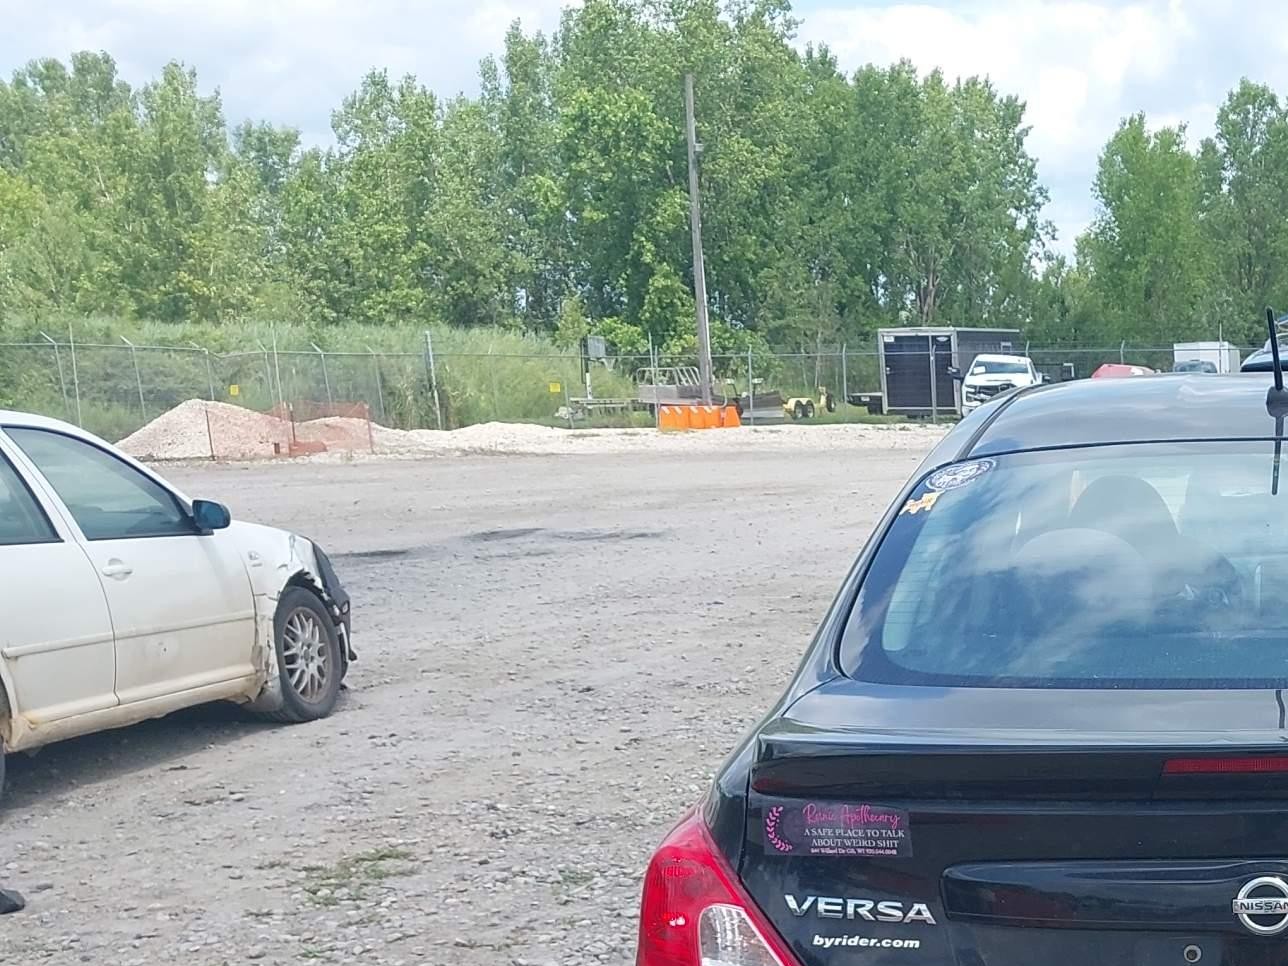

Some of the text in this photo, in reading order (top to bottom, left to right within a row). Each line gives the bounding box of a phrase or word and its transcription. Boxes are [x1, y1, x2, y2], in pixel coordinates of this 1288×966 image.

[811, 829, 834, 837] SAFE
[835, 829, 865, 837] PLACE
[866, 829, 880, 838] TO
[881, 829, 905, 838] TALK
[812, 838, 899, 848] ABOUT WEIRD SHIT
[784, 895, 936, 925] VERSA
[813, 934, 920, 949] byrider.com
